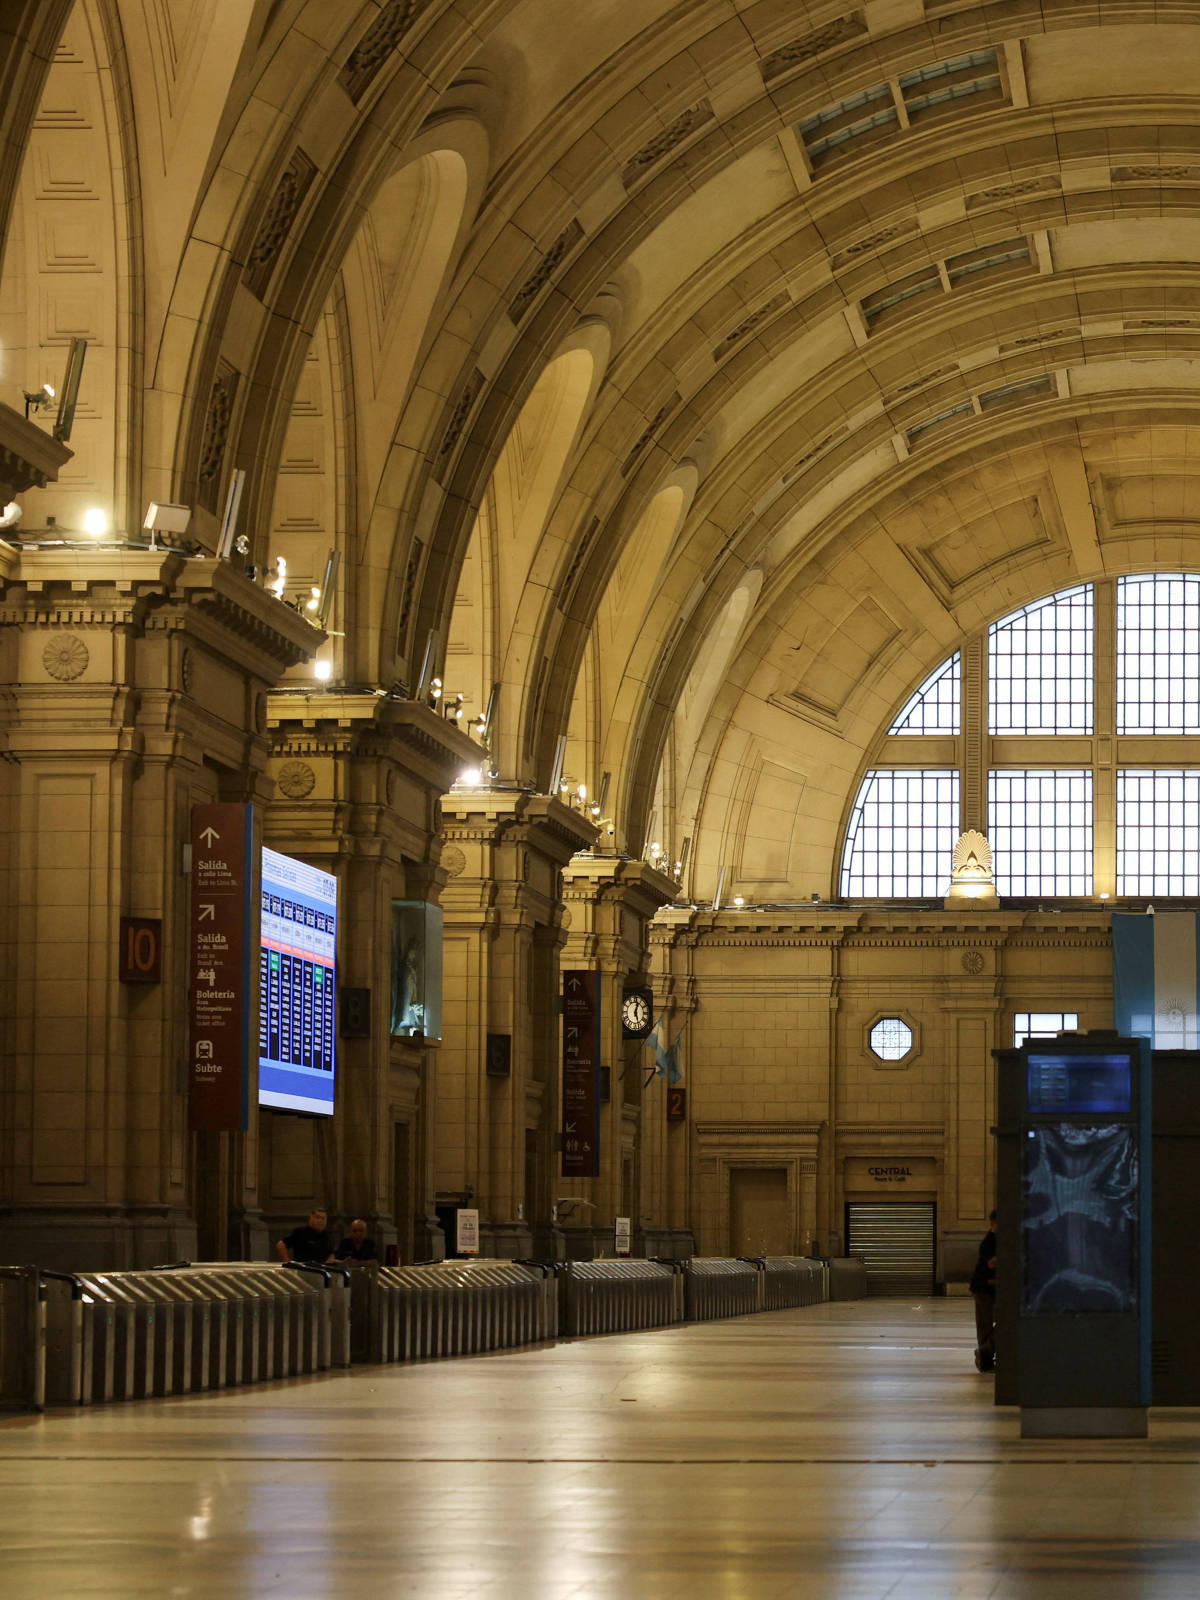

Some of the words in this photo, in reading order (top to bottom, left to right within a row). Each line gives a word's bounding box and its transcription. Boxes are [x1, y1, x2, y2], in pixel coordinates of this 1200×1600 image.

[198, 860, 228, 870] Salida
[197, 933, 226, 943] Salida
[195, 1063, 223, 1073] Subte
[671, 1093, 681, 1115] 2
[868, 1167, 912, 1177] CENTRAL
